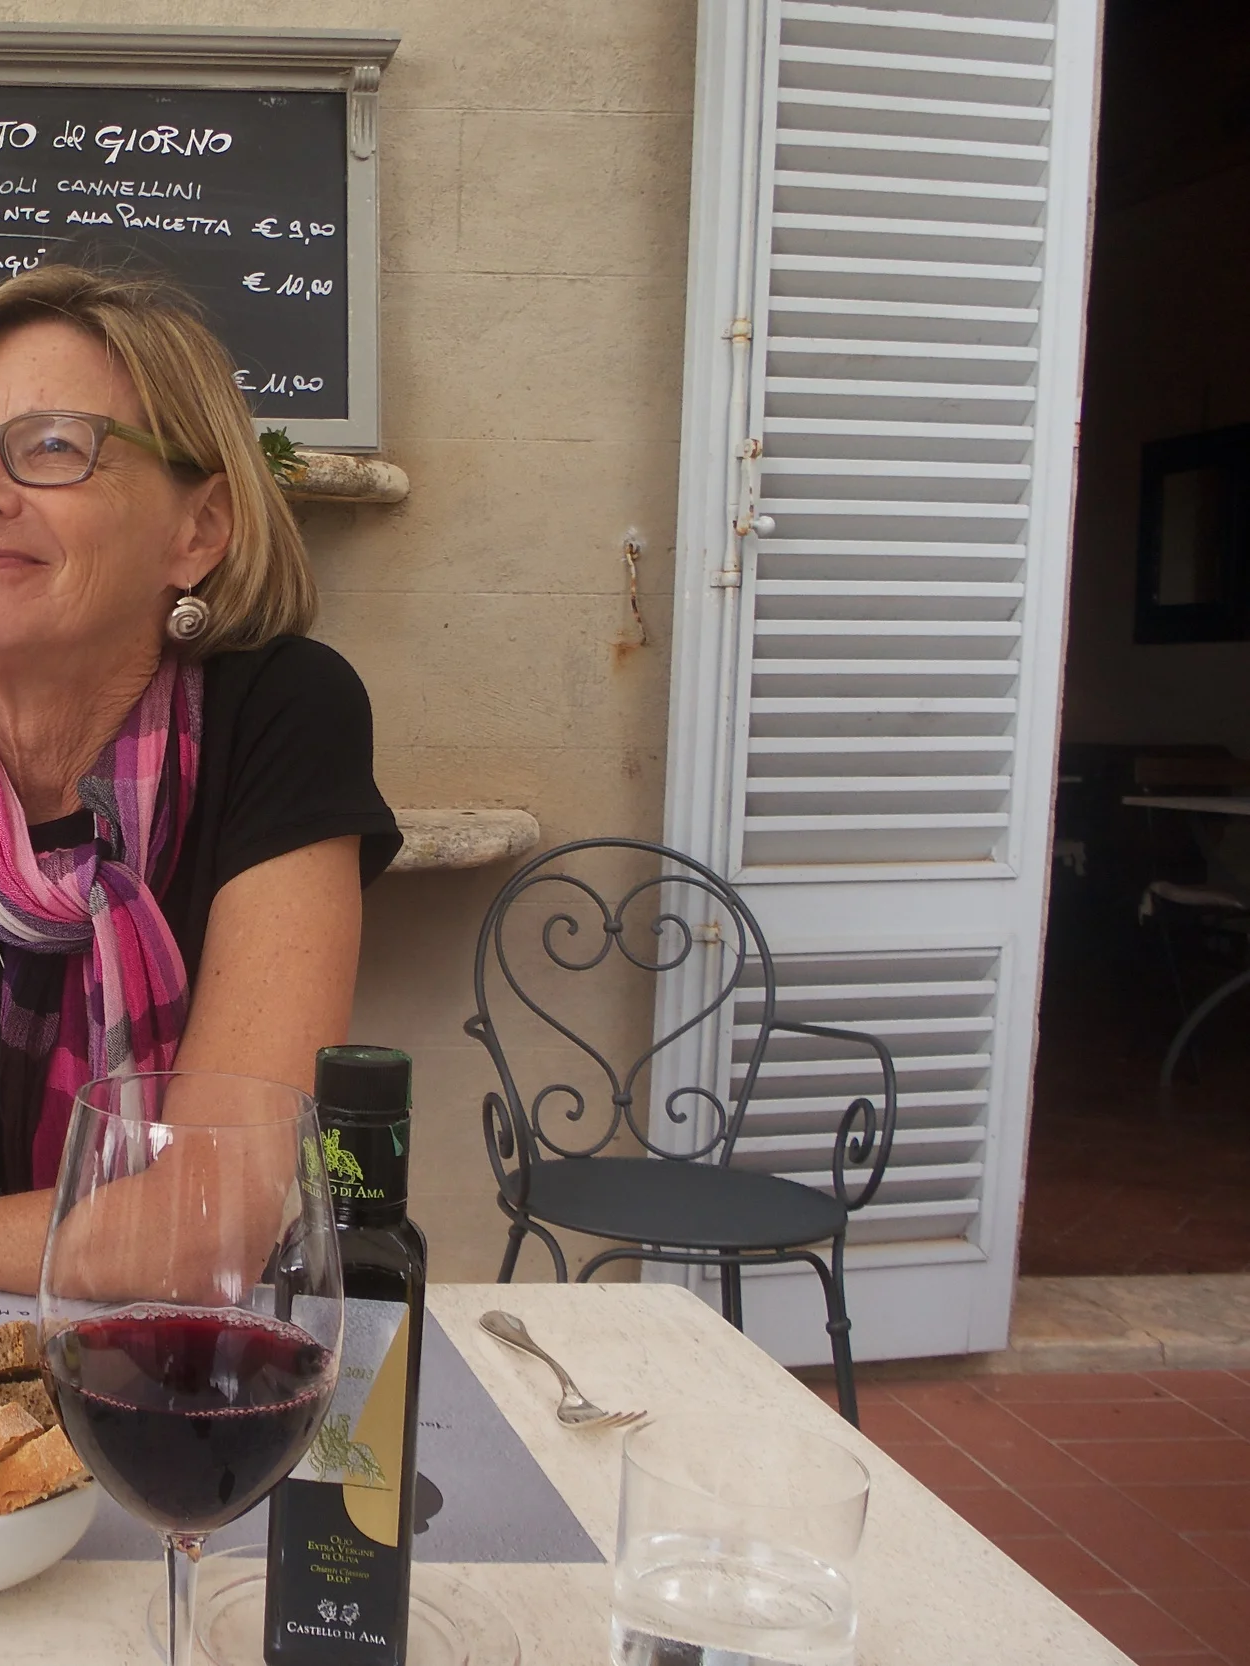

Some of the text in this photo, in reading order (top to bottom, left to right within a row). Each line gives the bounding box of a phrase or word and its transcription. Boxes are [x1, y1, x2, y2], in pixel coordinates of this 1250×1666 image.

[53, 120, 86, 151] del
[95, 125, 233, 164] GIORNO
[57, 179, 201, 200] CANNELLINI
[66, 210, 113, 226] ALLA
[116, 202, 231, 237] PANCETTA
[340, 1186, 352, 1197] DI
[355, 1185, 384, 1199] AMA
[307, 1540, 375, 1558] EXTRA VERGINE
[321, 1552, 359, 1565] DI OLIVA
[286, 1621, 387, 1646] CASTELLO DI AMA
